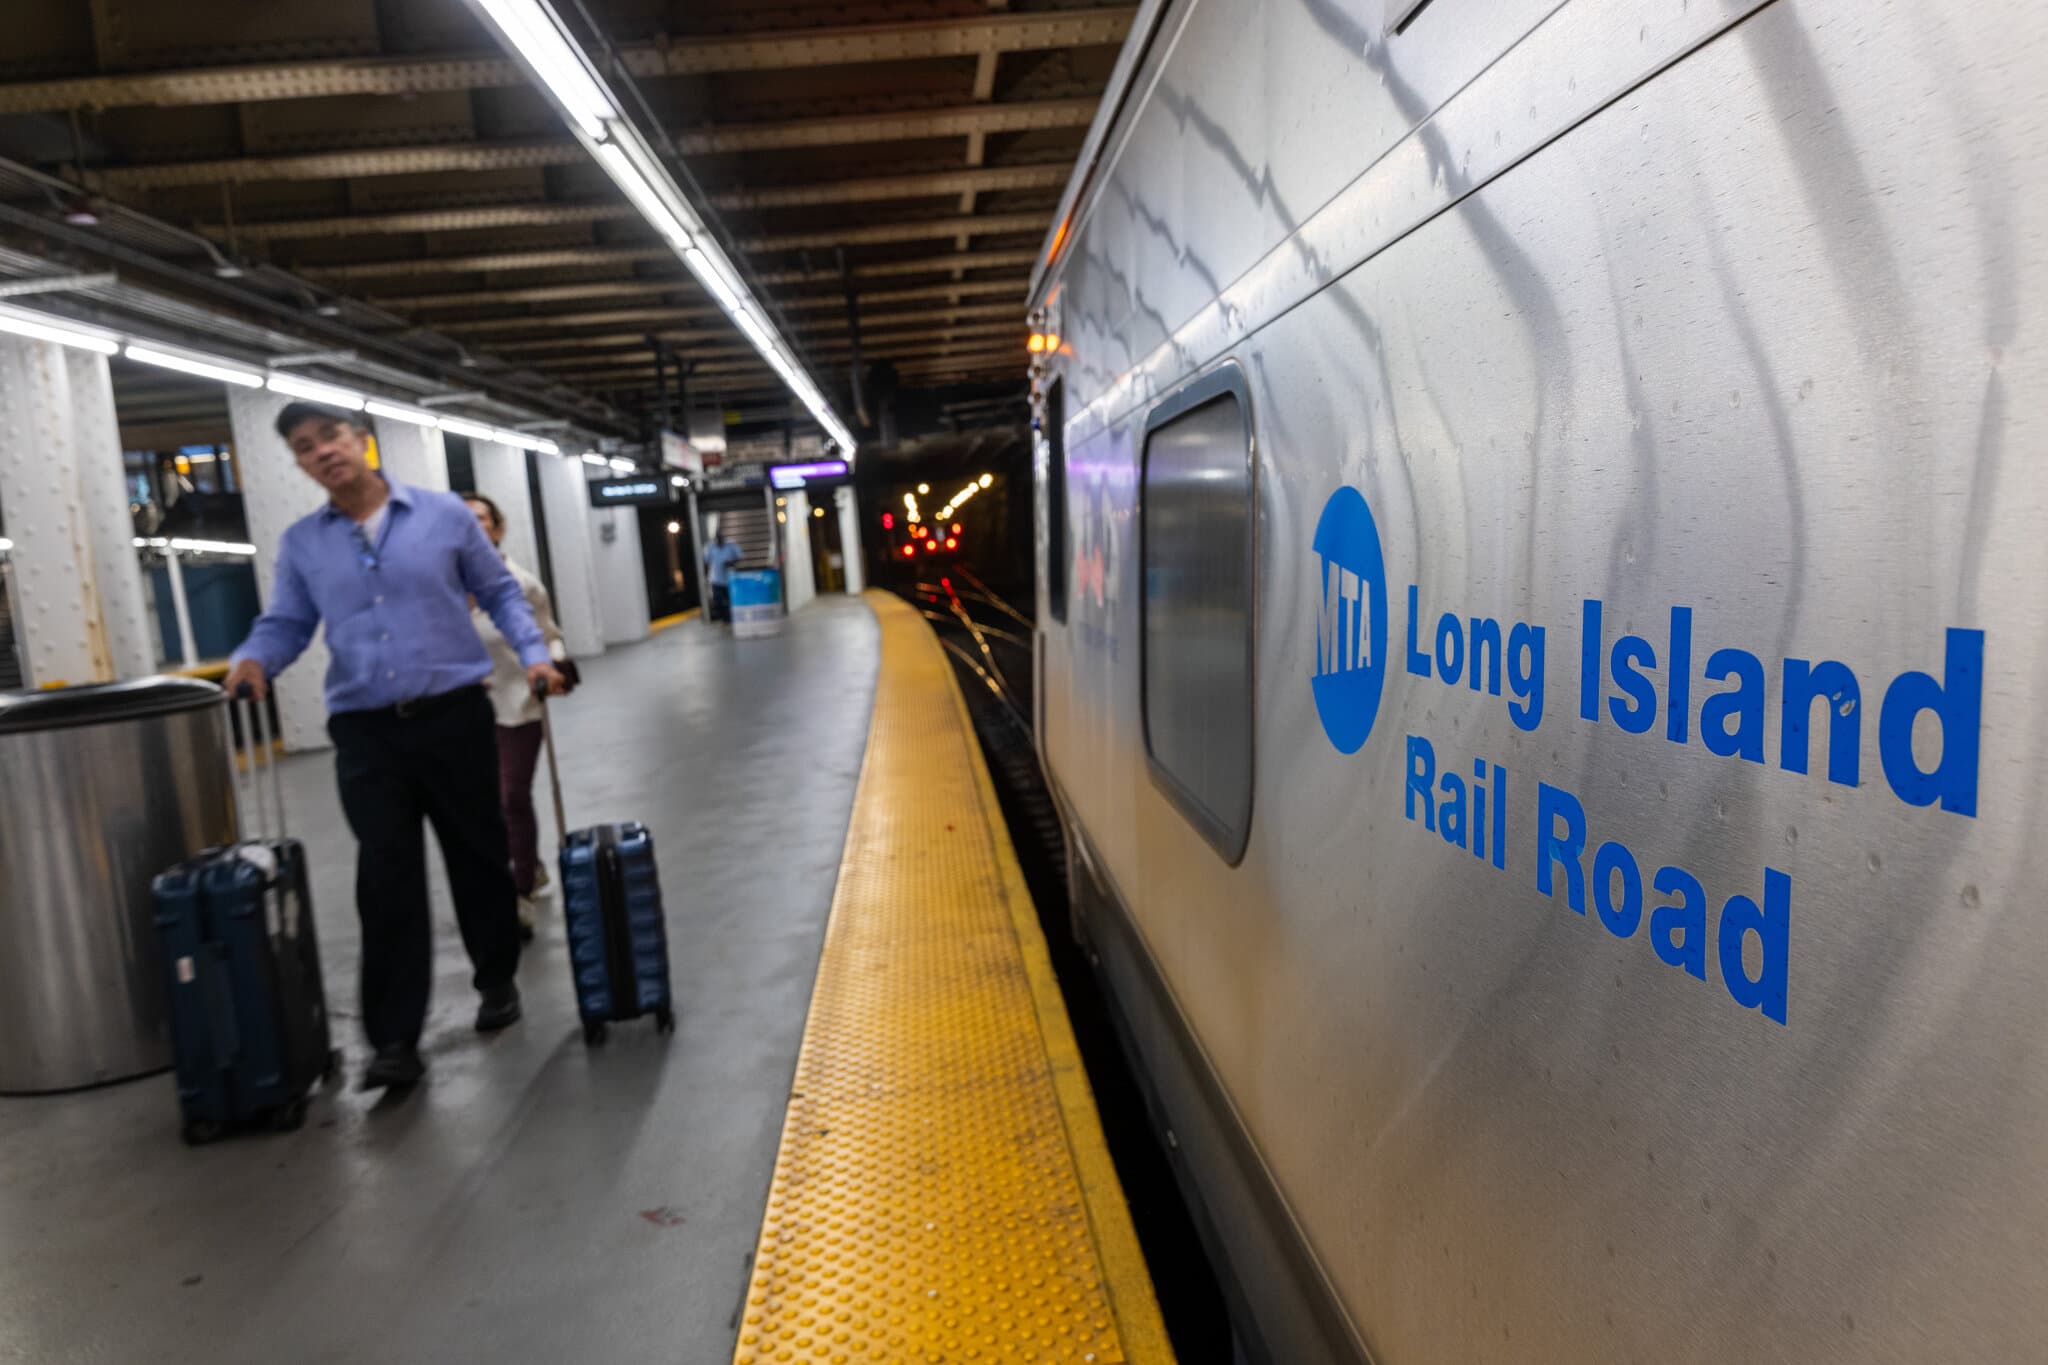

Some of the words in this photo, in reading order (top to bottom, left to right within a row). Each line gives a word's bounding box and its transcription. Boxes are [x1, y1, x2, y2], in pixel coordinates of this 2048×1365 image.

[1313, 550, 1372, 676] MTA
[1406, 585, 1545, 731] Long
[1580, 599, 1984, 818] Island
[1405, 735, 1506, 870] Rail
[1537, 782, 1791, 1026] Road
